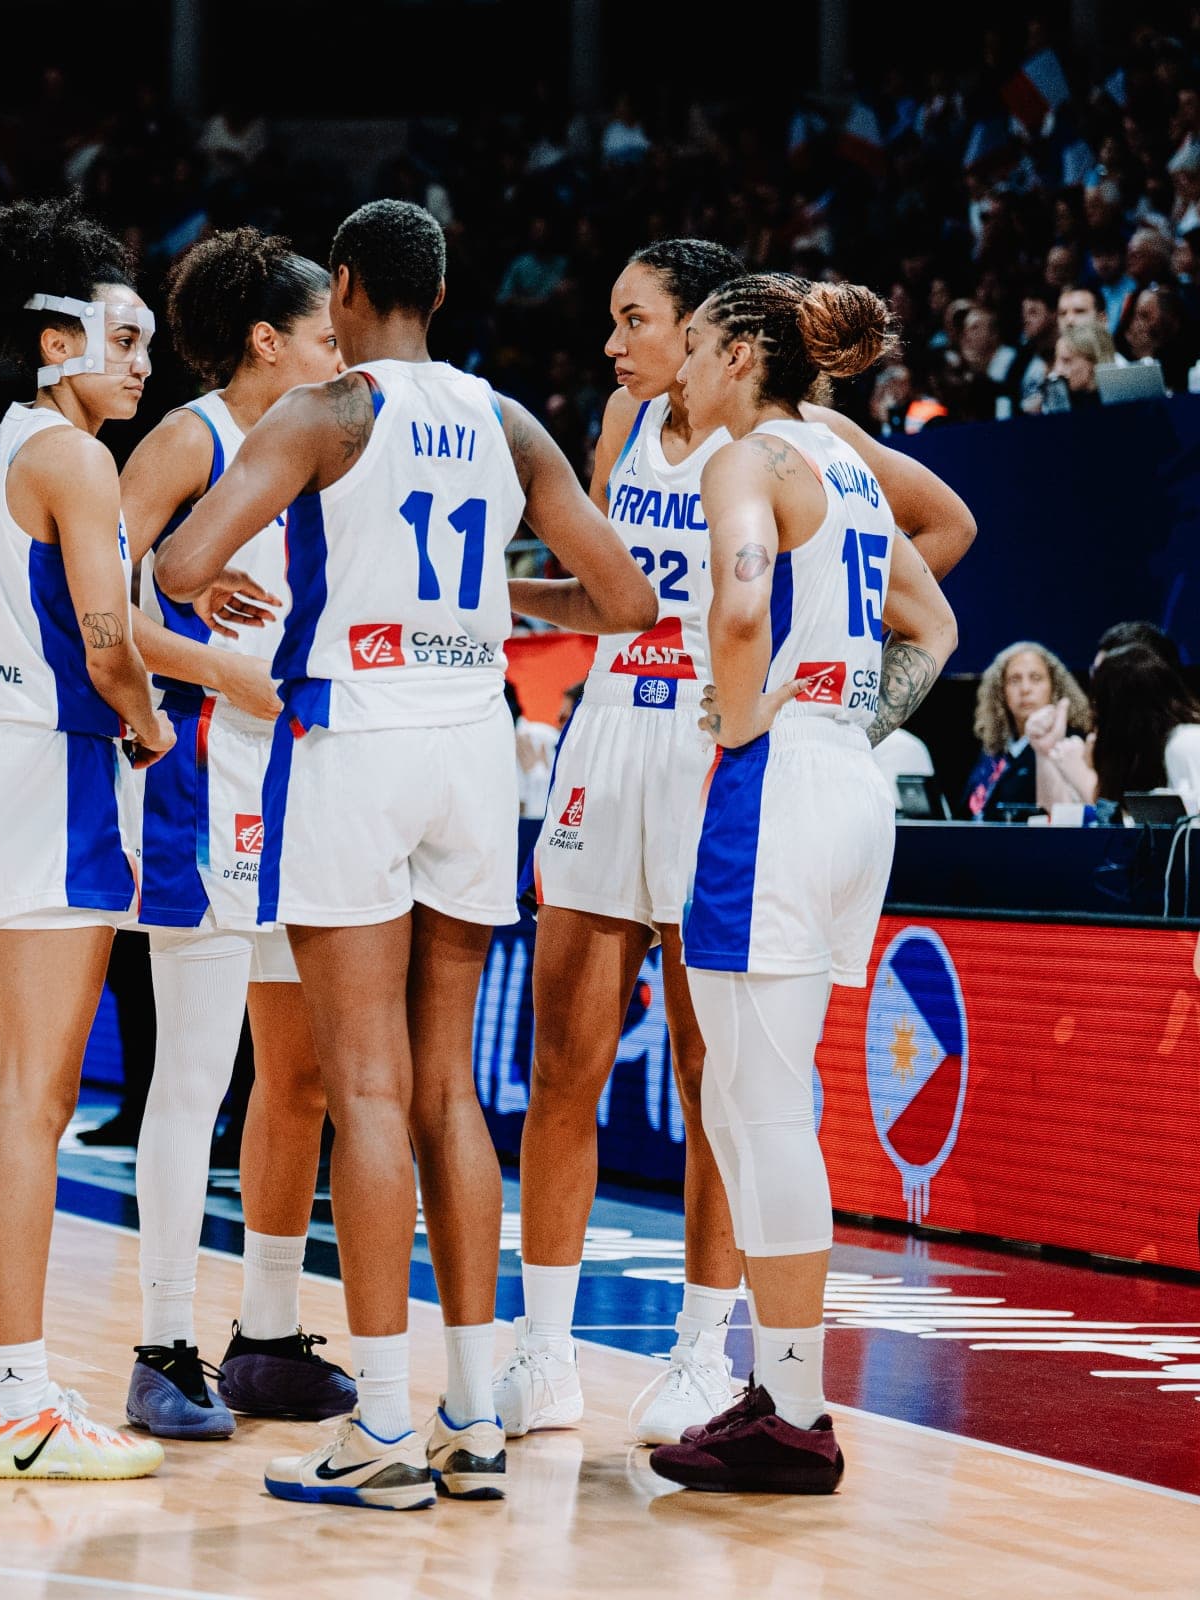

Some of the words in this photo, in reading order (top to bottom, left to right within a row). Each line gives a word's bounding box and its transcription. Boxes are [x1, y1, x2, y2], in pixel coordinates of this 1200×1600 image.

[411, 421, 476, 462] AYAYI
[611, 484, 709, 531] FRANC
[825, 461, 879, 509] WILLIAMS
[398, 490, 488, 611] 11
[842, 528, 888, 642] 15
[223, 869, 258, 882] D'EPAR
[236, 861, 259, 872] CAIS
